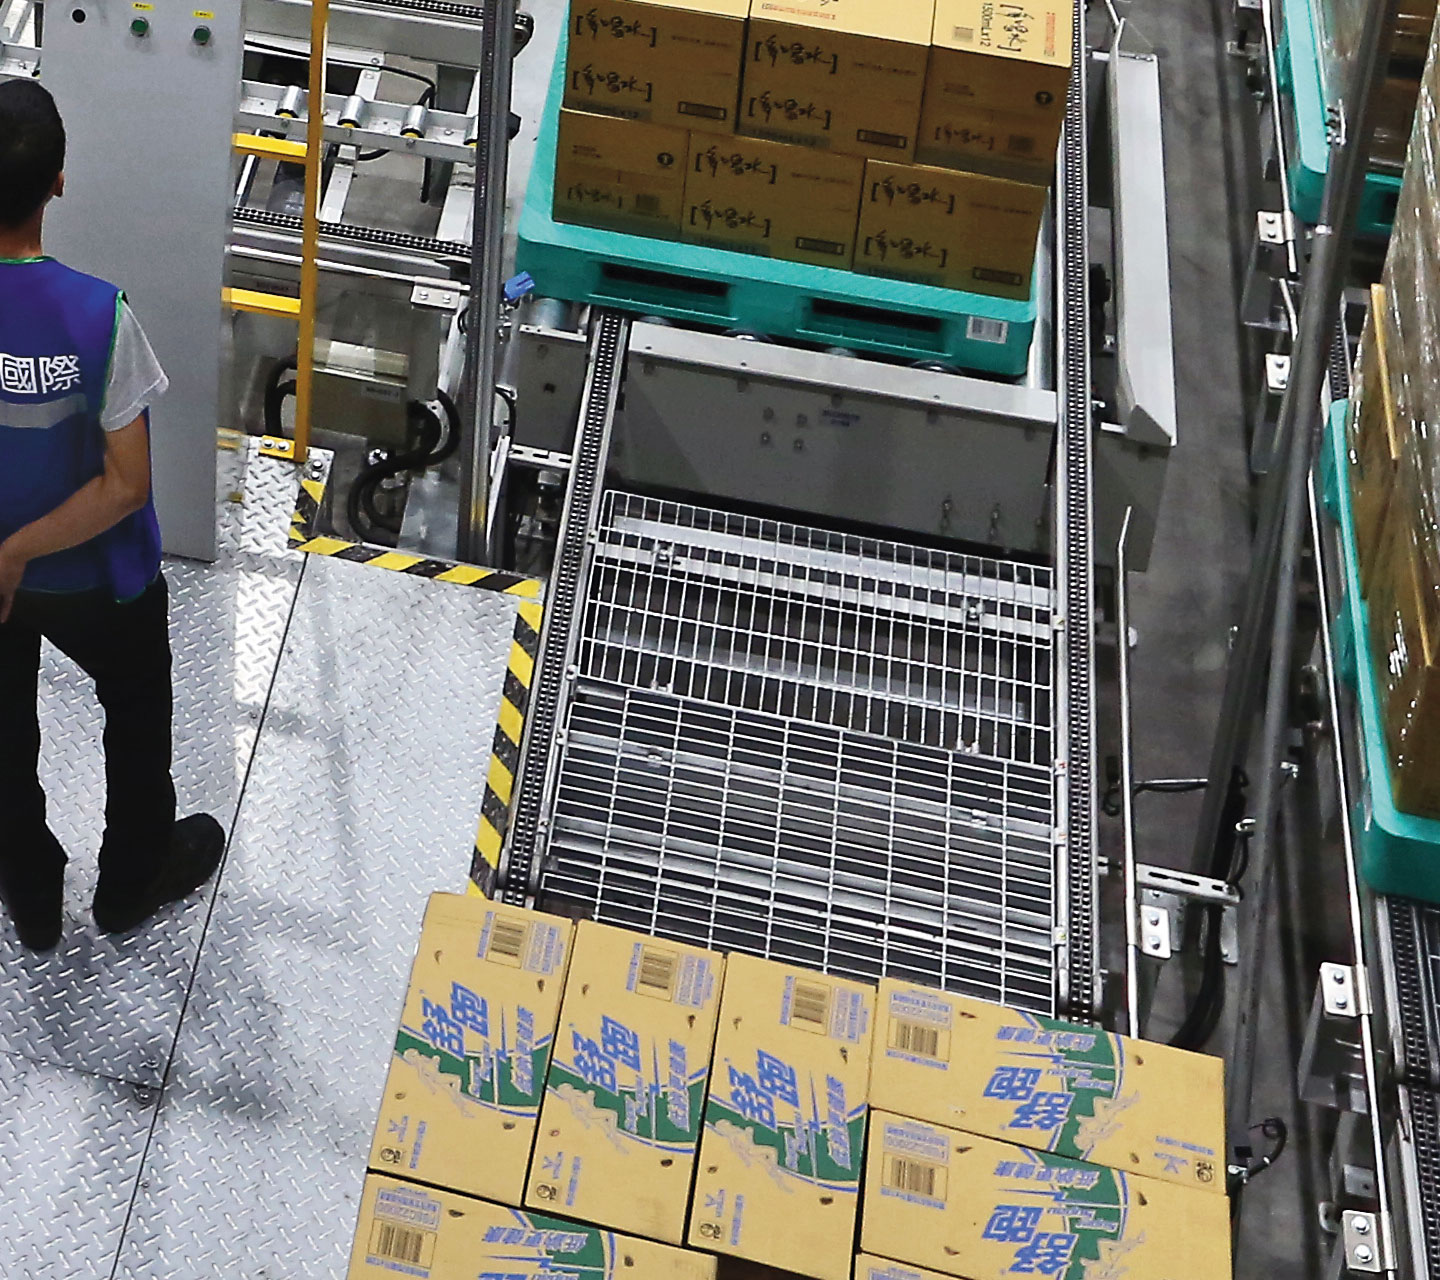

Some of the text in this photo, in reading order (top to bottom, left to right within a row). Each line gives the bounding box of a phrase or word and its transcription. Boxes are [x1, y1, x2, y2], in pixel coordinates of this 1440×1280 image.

[422, 981, 489, 1061] 舒跑
[510, 1004, 534, 1097] 低鈉更健康
[572, 1014, 641, 1096] 舒跑
[996, 1025, 1095, 1051] 低鈉更健康
[668, 1038, 690, 1133] 低鈉更健康
[728, 1048, 800, 1133] 舒跑
[826, 1073, 852, 1171] 低鈉更健康
[983, 1066, 1075, 1131] 舒跑
[994, 1160, 1100, 1190] 低鈉更健康
[481, 1225, 589, 1254] 低鈉更健康
[982, 1204, 1079, 1275] 舒跑
